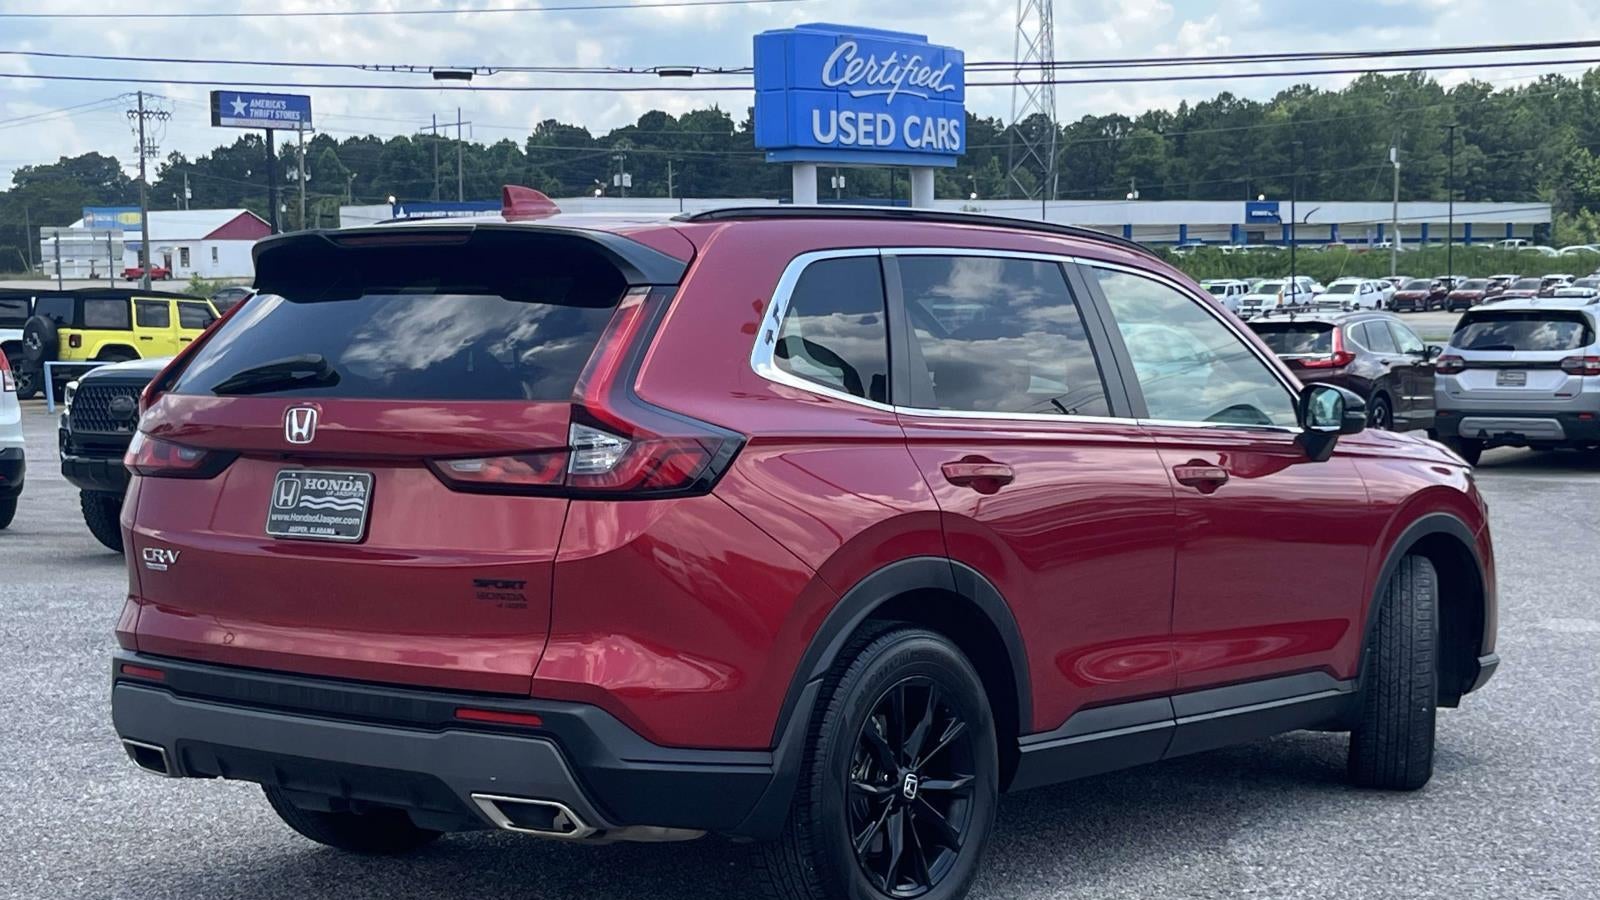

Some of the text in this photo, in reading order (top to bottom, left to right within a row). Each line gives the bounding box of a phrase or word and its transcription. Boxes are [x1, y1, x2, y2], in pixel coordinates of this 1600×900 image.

[822, 41, 956, 105] Certified
[250, 99, 287, 110] AMERICA'S
[250, 109, 301, 120] THRIFT STORES
[812, 109, 960, 151] USED CARS
[304, 478, 365, 492] HONDA
[271, 512, 360, 526] www.HondaofJasper.com
